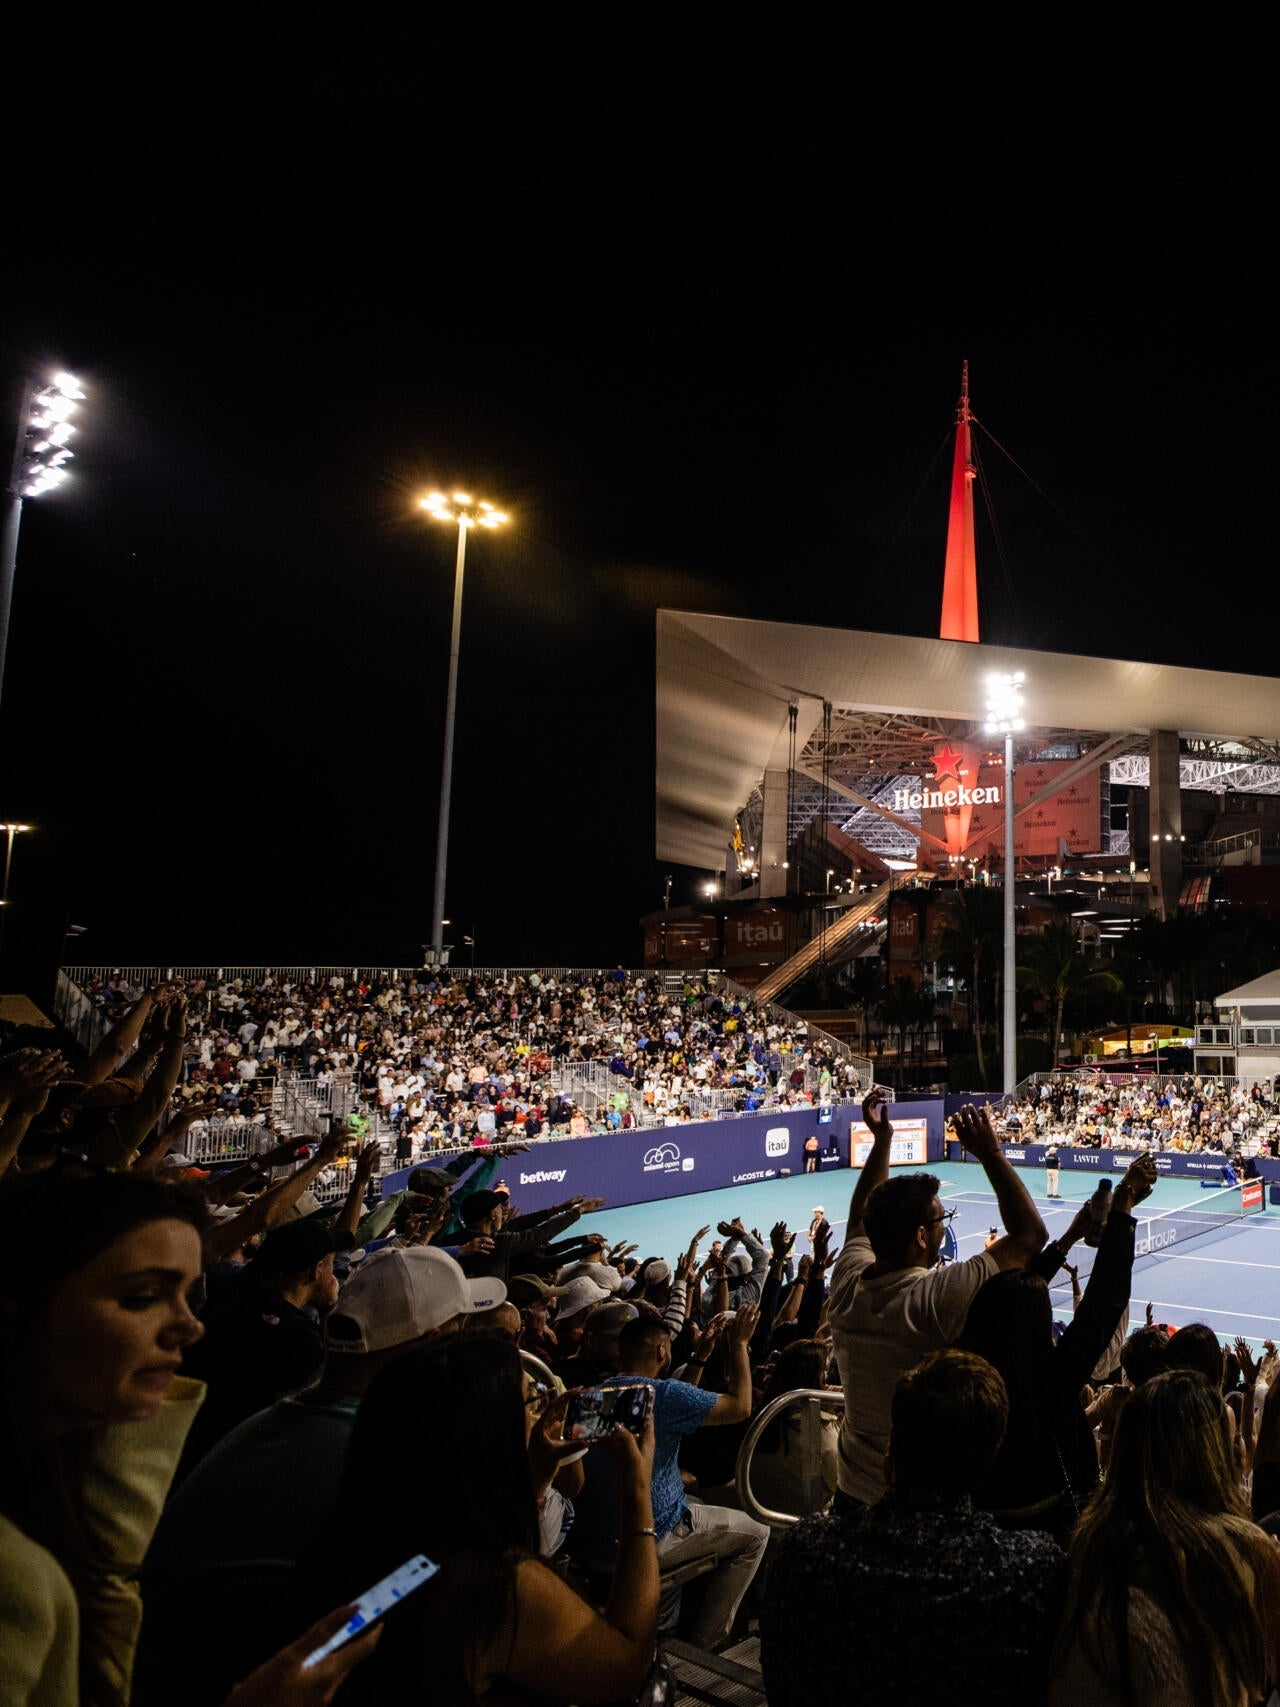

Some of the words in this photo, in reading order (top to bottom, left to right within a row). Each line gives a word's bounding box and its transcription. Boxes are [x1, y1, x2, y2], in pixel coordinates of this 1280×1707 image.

[893, 784, 1000, 811] Heineken
[643, 1162, 664, 1172] miami
[664, 1160, 680, 1169] open
[1073, 1154, 1100, 1163] LASVIT
[519, 1169, 567, 1185] betway
[733, 1169, 764, 1183] LACOSTE
[1150, 1229, 1176, 1250] TOUR
